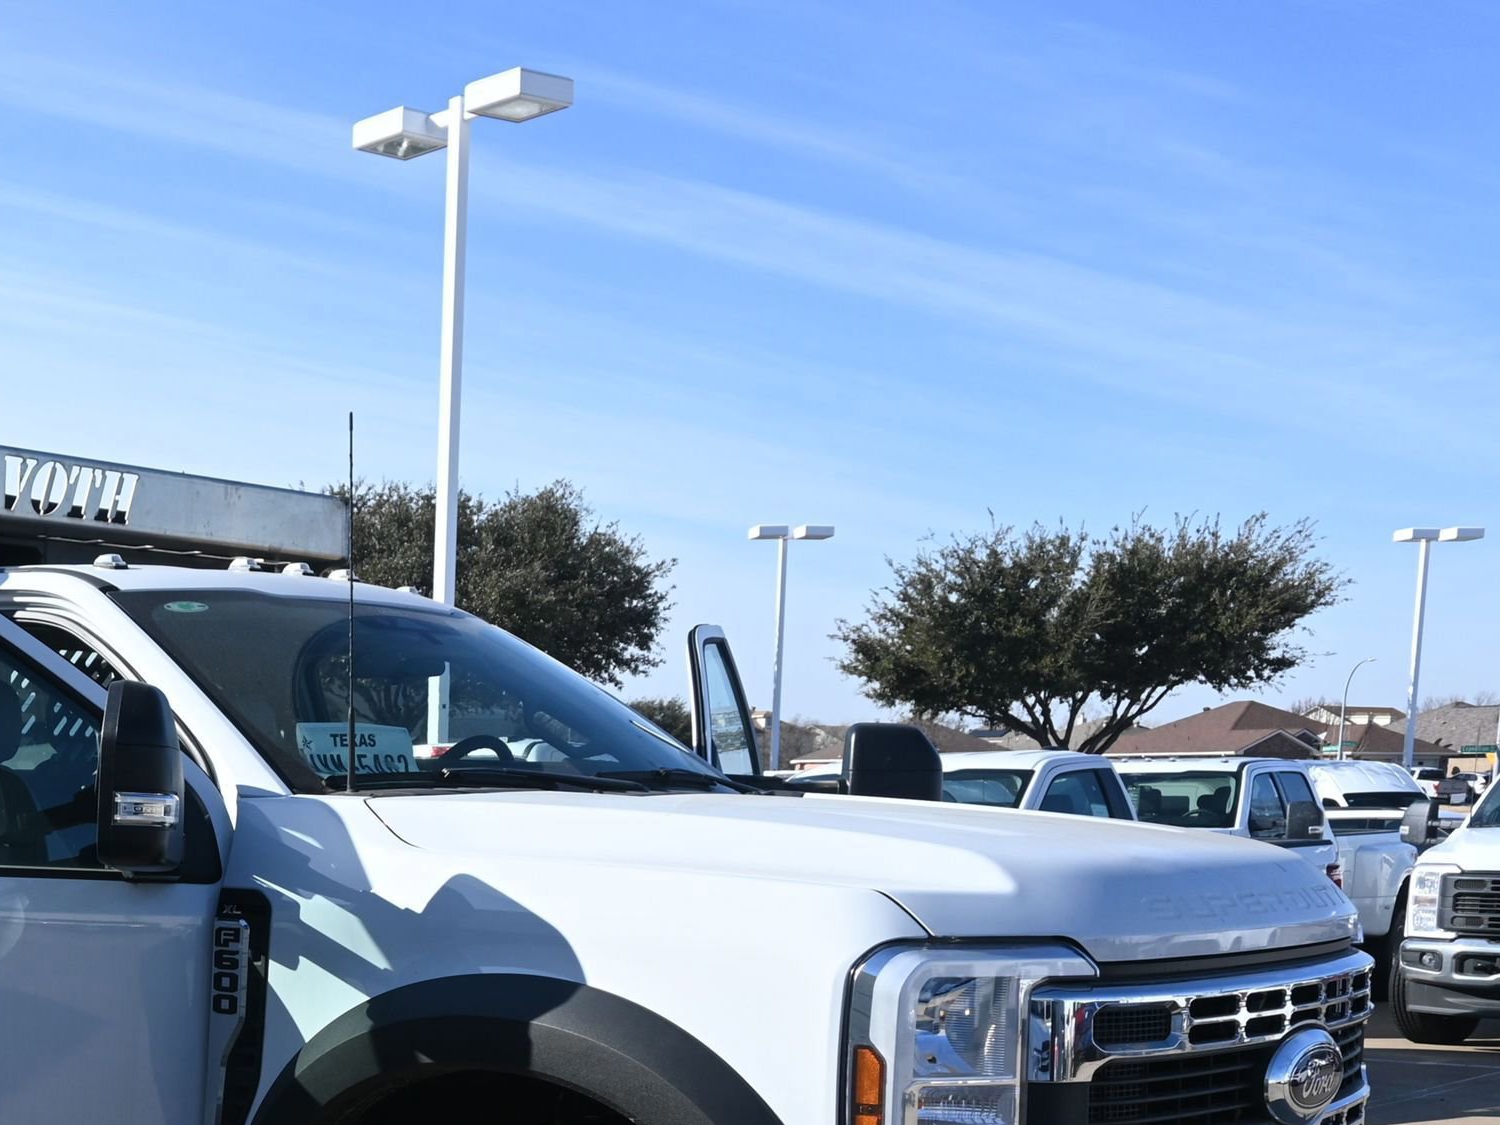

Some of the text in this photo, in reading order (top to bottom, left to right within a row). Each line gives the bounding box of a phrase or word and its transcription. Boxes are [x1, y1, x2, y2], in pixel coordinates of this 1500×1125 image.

[4, 455, 139, 525] VOTH
[222, 904, 242, 914] XL
[1302, 1058, 1336, 1099] Ford
